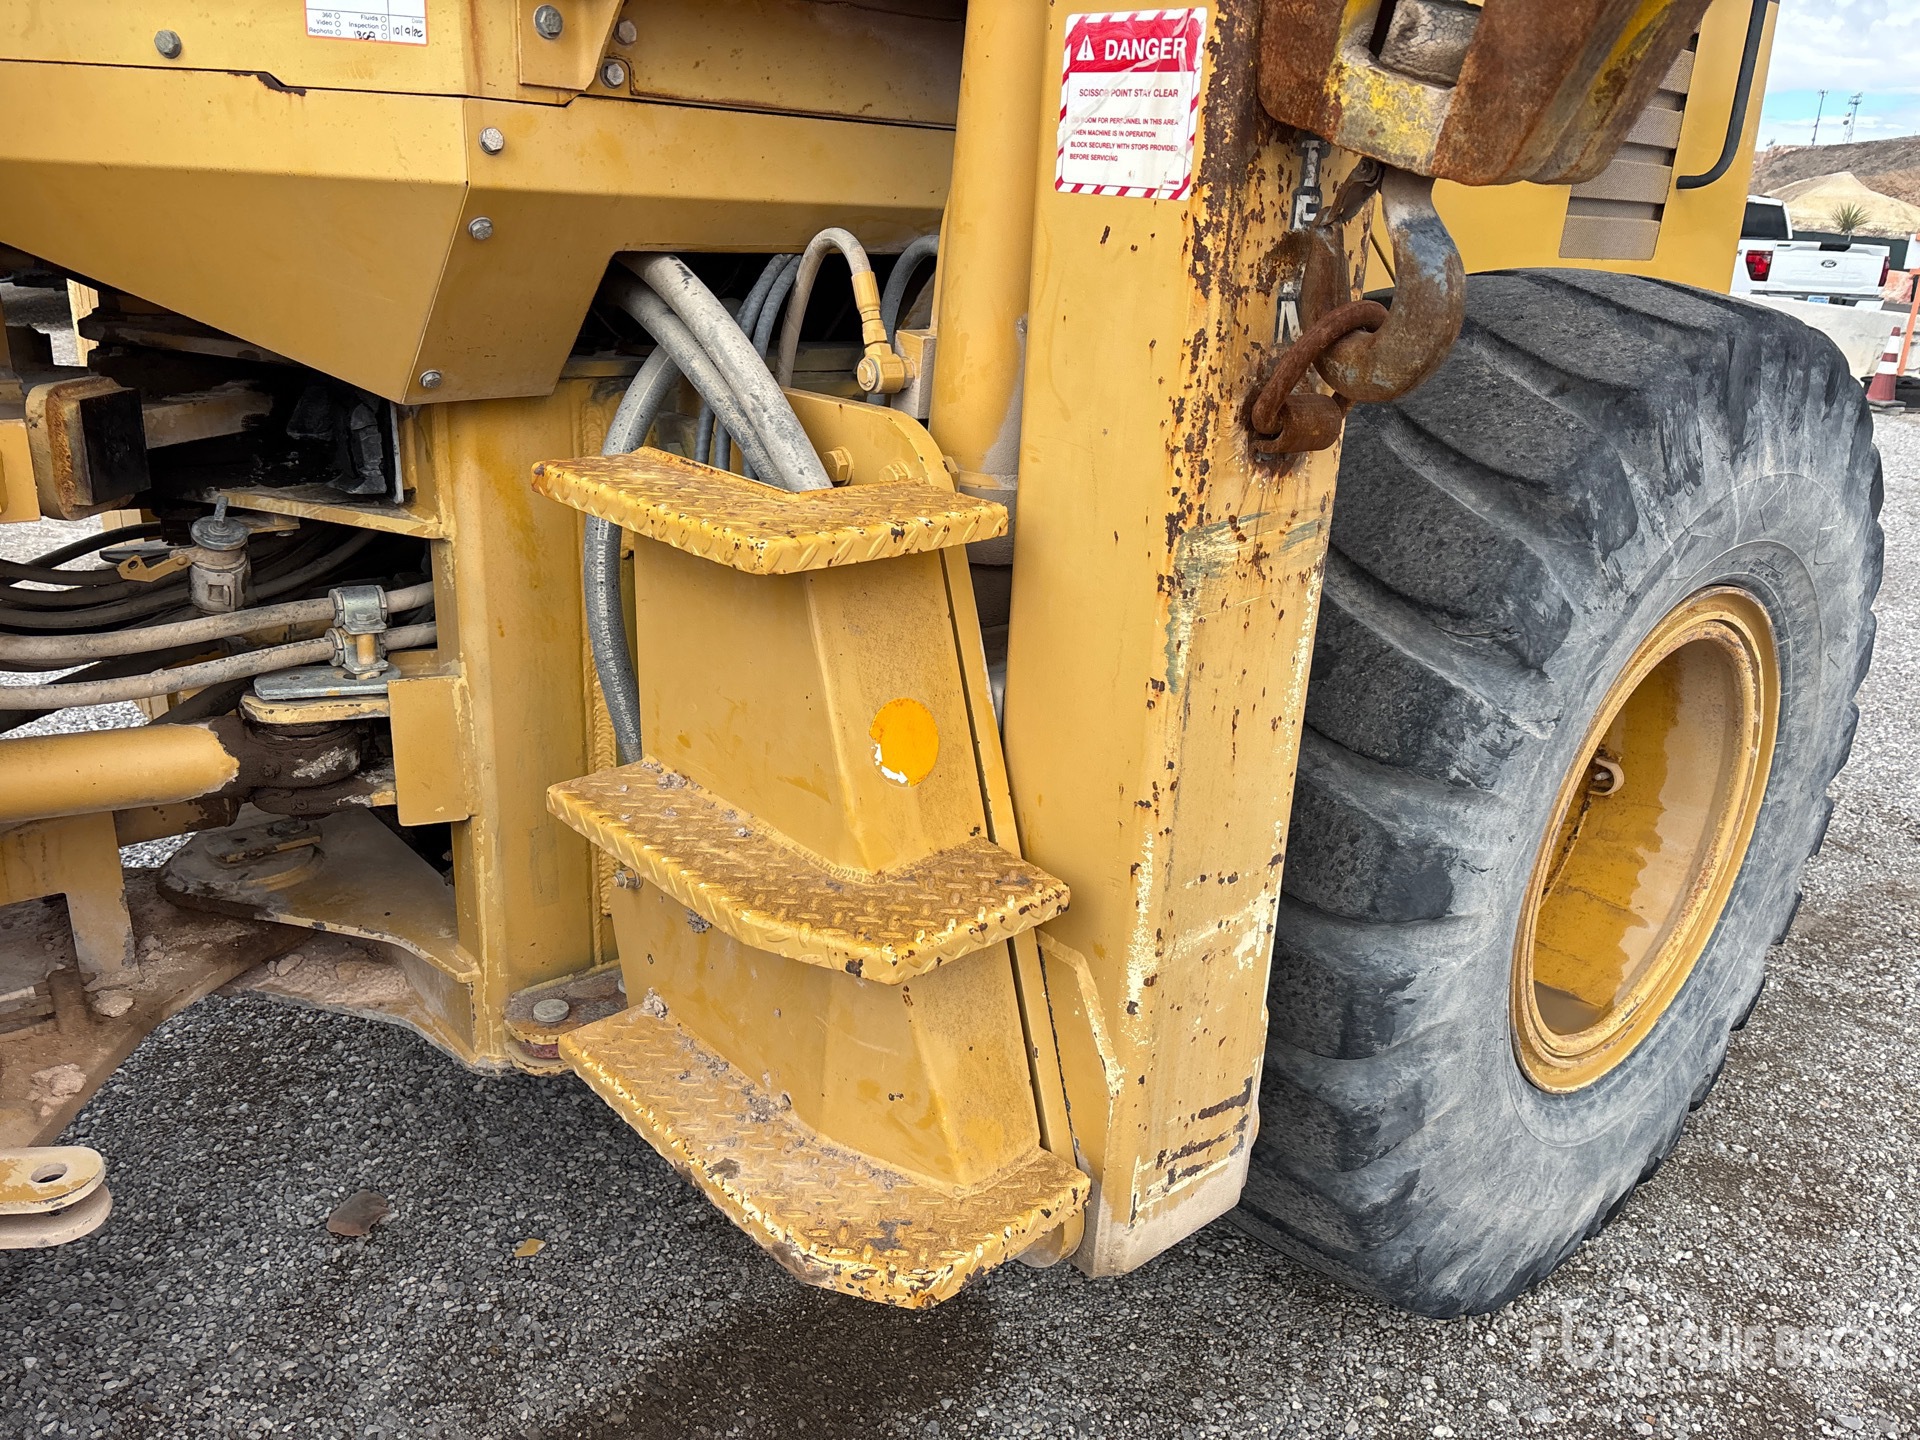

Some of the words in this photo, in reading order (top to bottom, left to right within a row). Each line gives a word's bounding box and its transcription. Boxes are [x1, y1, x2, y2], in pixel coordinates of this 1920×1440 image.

[360, 14, 379, 22] Fluids
[309, 27, 334, 35] Rephoto
[348, 22, 380, 30] Inspection
[1104, 37, 1187, 61] DANGER
[1110, 88, 1132, 97] POINT
[1133, 88, 1152, 97] STAY
[1153, 88, 1179, 97] CLEAR
[1098, 117, 1109, 125] FOR
[1142, 117, 1149, 125] IN
[1149, 117, 1162, 125] THIS
[1087, 129, 1111, 137] MACHINE
[1125, 130, 1157, 138] OPERATION
[1070, 141, 1088, 149] BLOCK
[1088, 141, 1116, 149] SECURELY
[1116, 142, 1130, 150] WITH
[1131, 143, 1149, 151] STOPS
[1149, 143, 1179, 152] PROVIDED
[1069, 153, 1090, 161] BEFORE
[1090, 153, 1118, 161] SERVICING
[597, 543, 606, 582] TOUGH
[598, 585, 608, 617] COVER
[601, 619, 614, 660] 451TC-16
[608, 658, 618, 674] WP
[611, 674, 622, 692] 21.0
[616, 691, 628, 710] MPa
